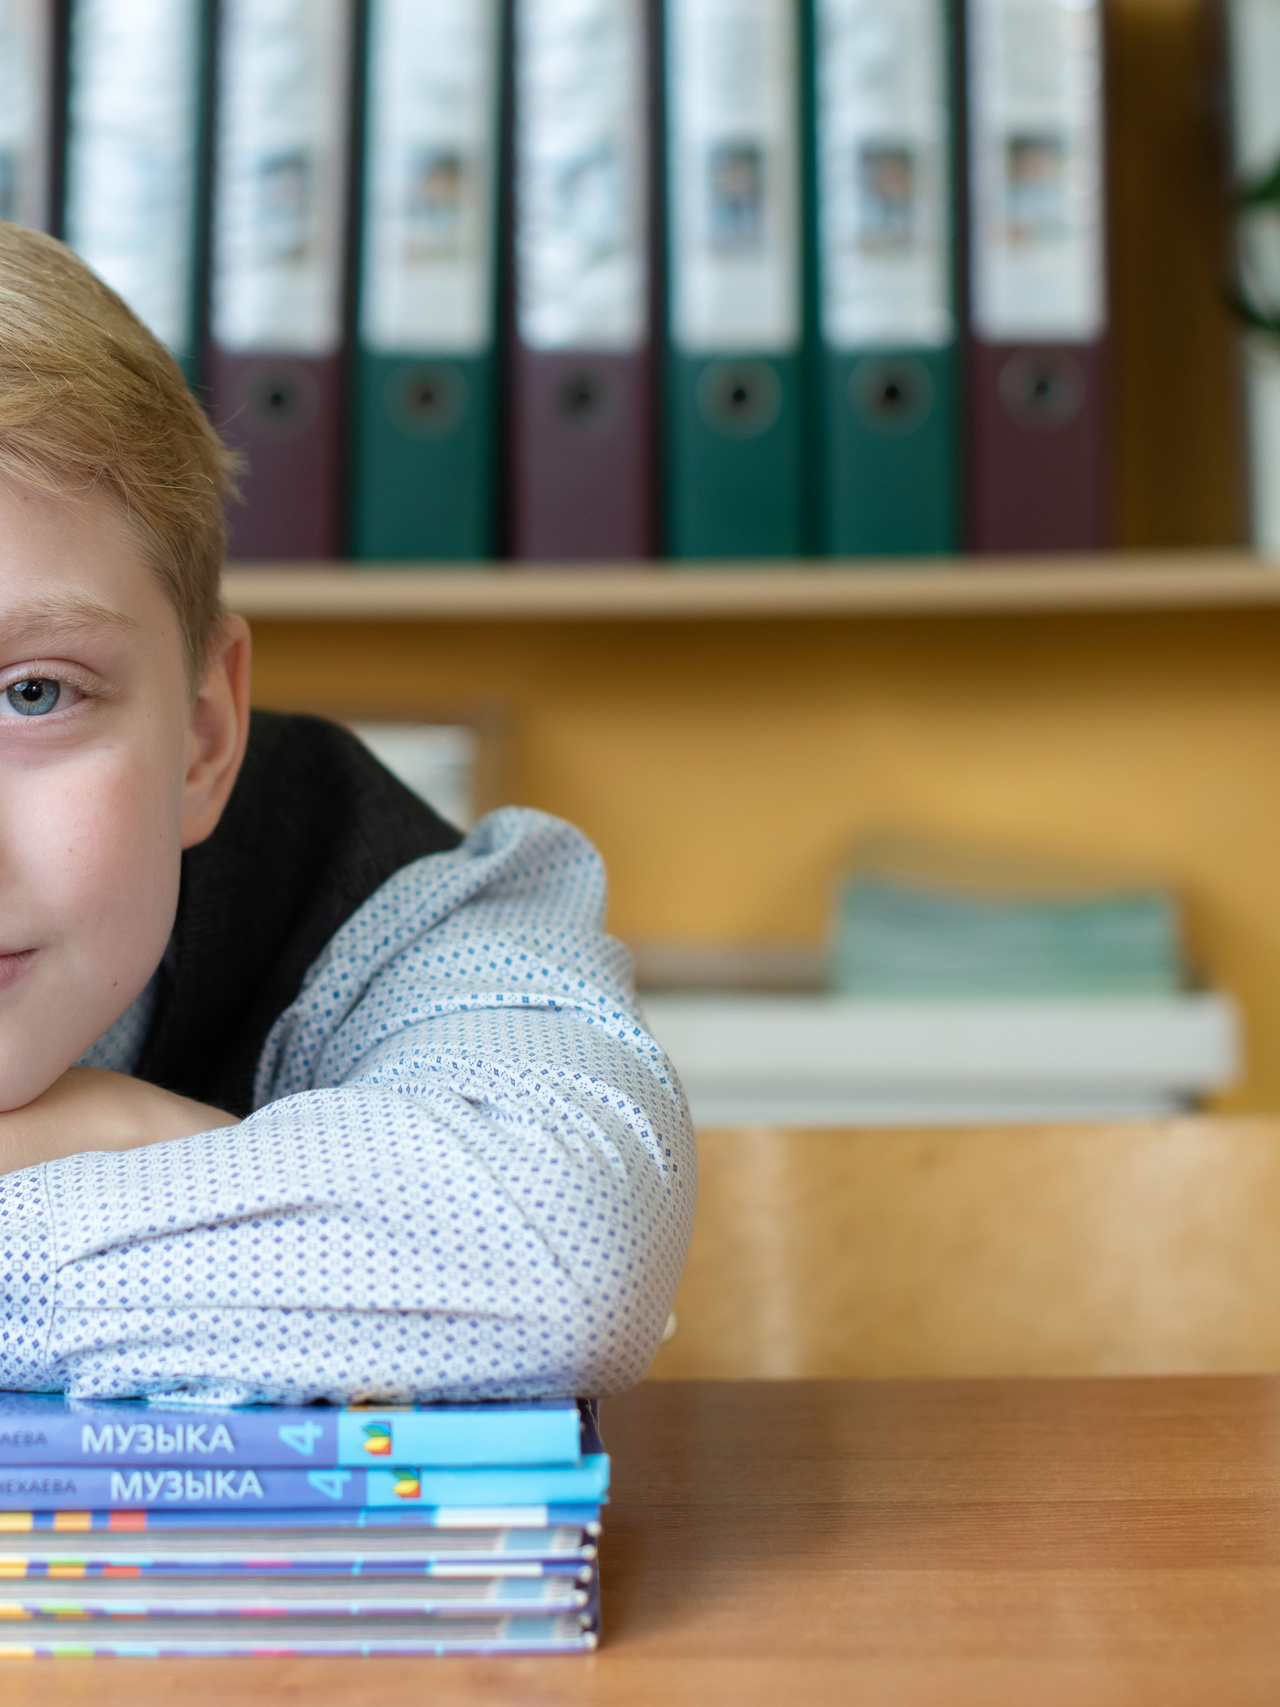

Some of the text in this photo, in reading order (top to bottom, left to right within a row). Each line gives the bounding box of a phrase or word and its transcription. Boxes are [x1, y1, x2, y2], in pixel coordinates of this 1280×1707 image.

[81, 1423, 235, 1454] МУЗЫКА
[278, 1420, 323, 1456] 4
[111, 1469, 264, 1500] МУЗЫКА
[307, 1469, 352, 1499] 4
